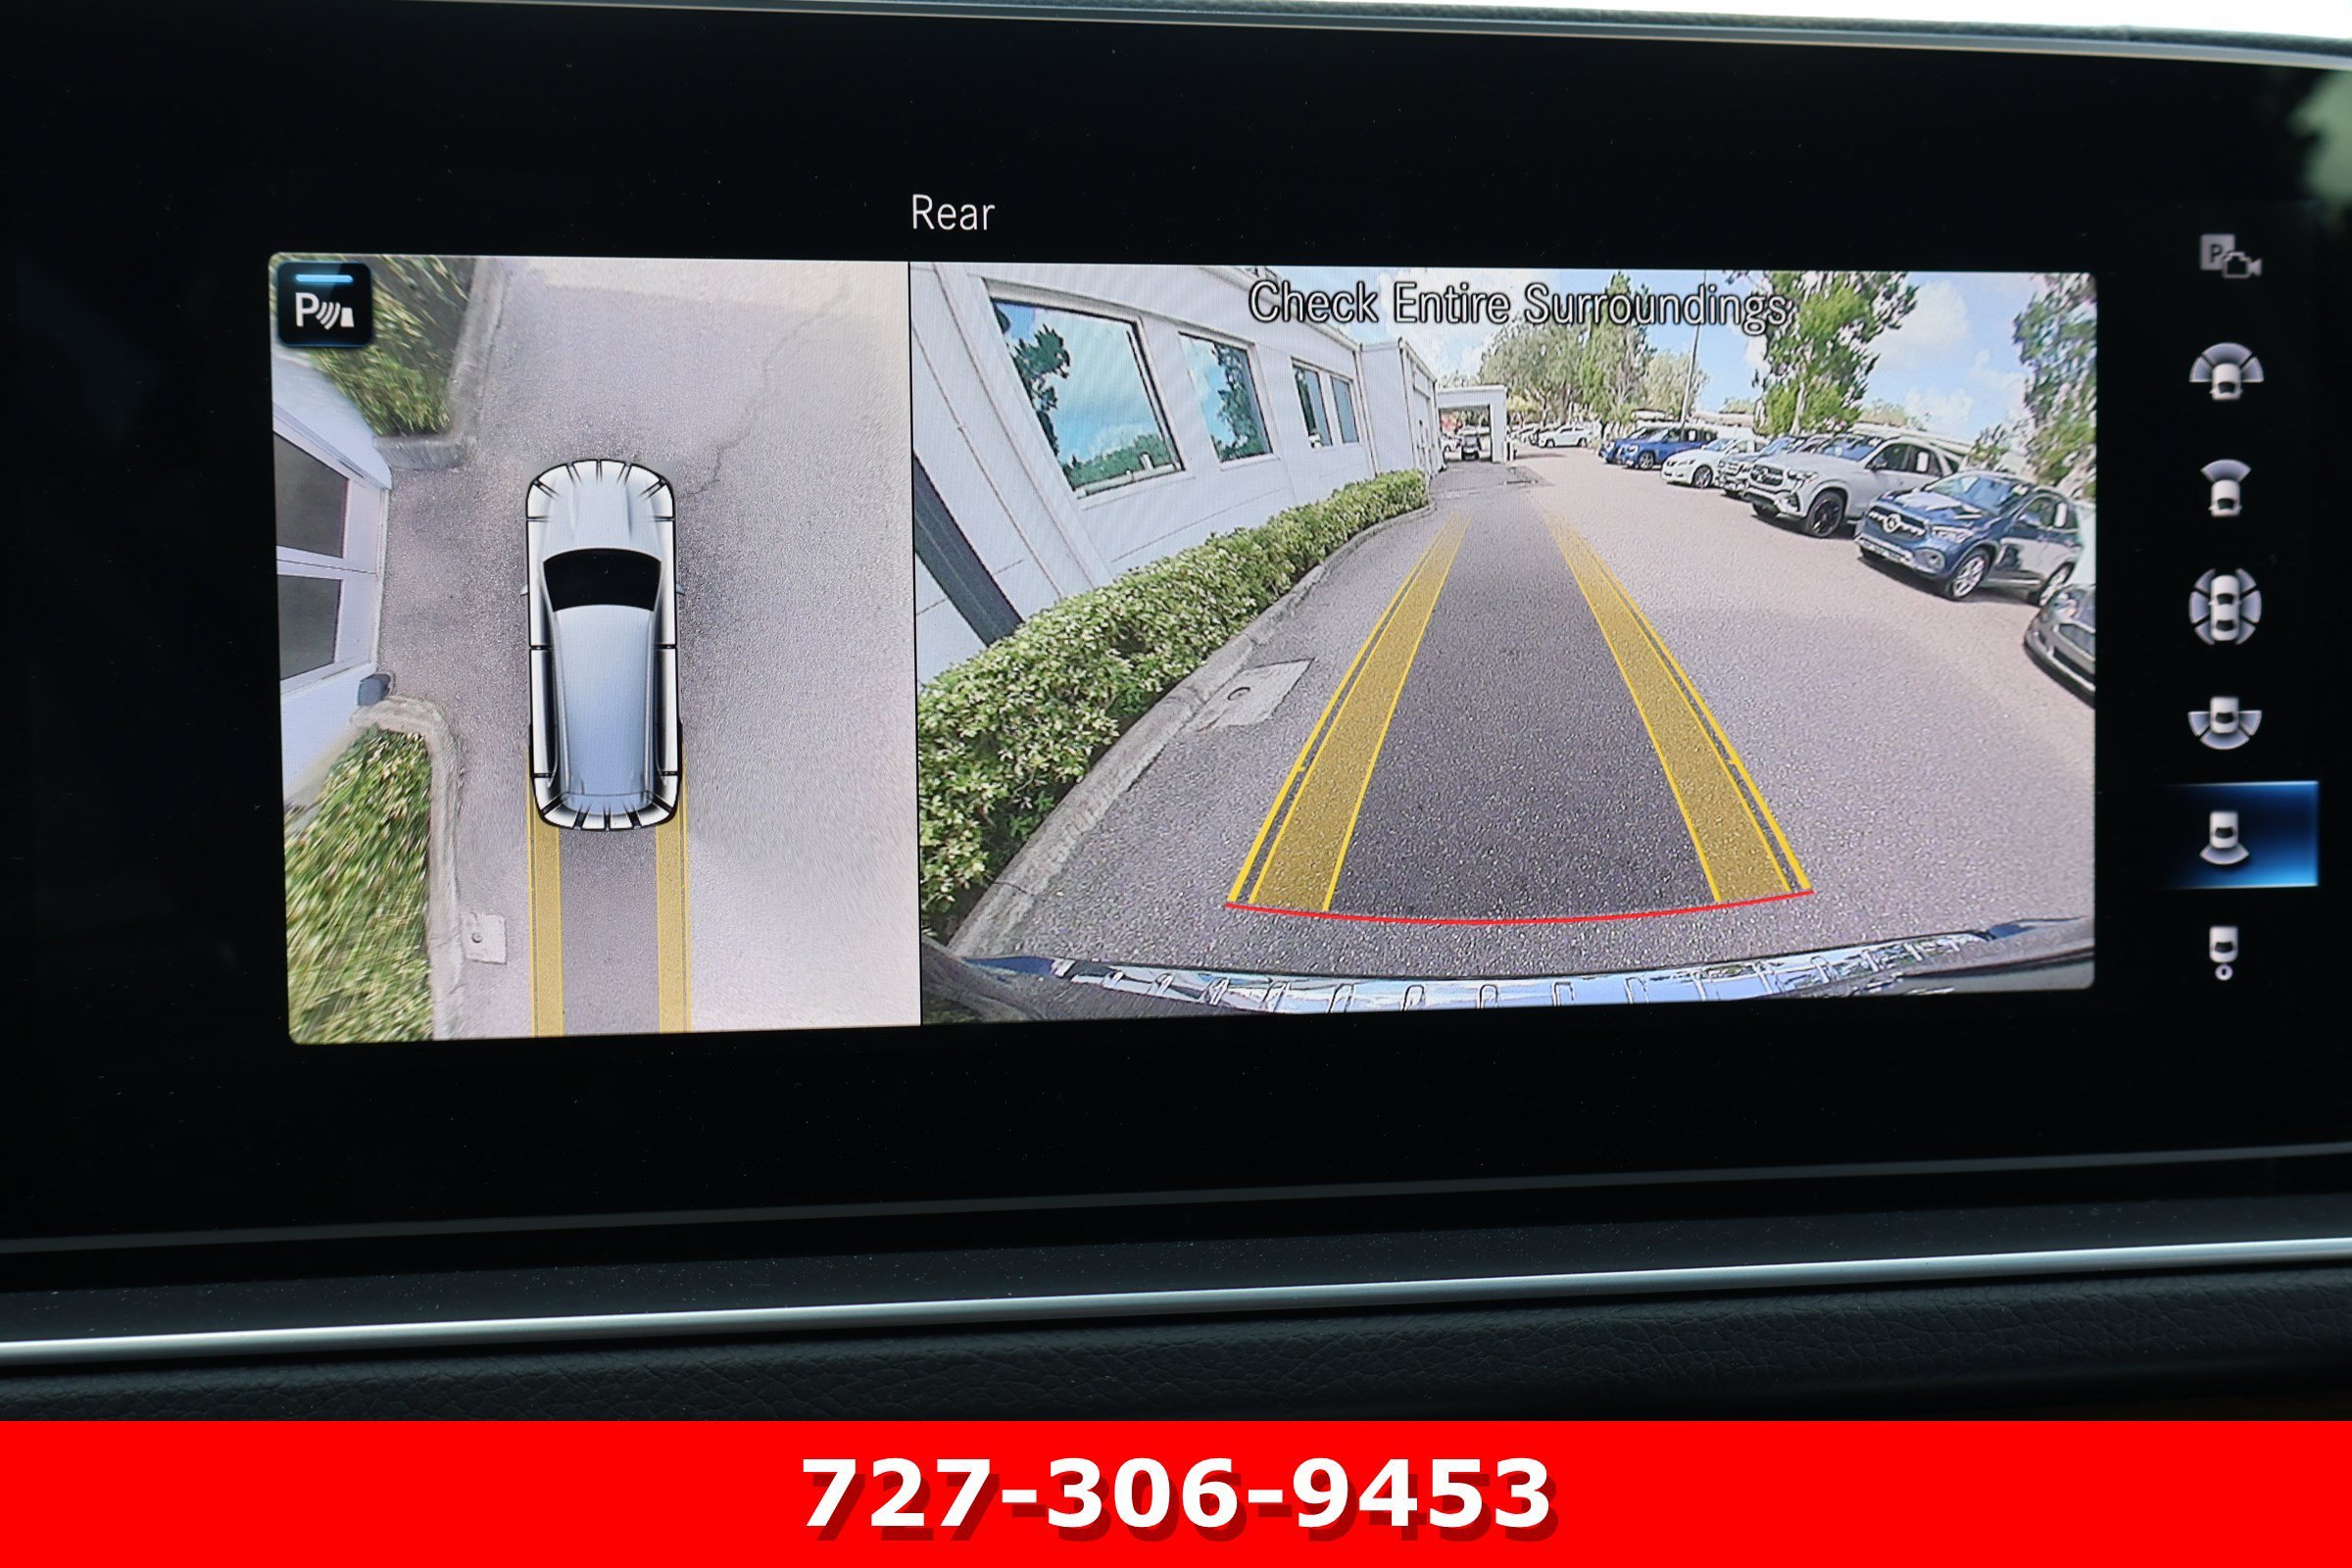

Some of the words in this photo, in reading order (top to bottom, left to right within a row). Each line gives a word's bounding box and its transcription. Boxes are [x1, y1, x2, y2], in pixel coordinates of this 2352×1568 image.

[910, 194, 995, 231] Rear
[2210, 243, 2224, 264] P
[295, 292, 319, 327] P
[1248, 280, 1378, 323] Check
[1393, 282, 1510, 325] Entire
[1524, 284, 1789, 335] Surroundings
